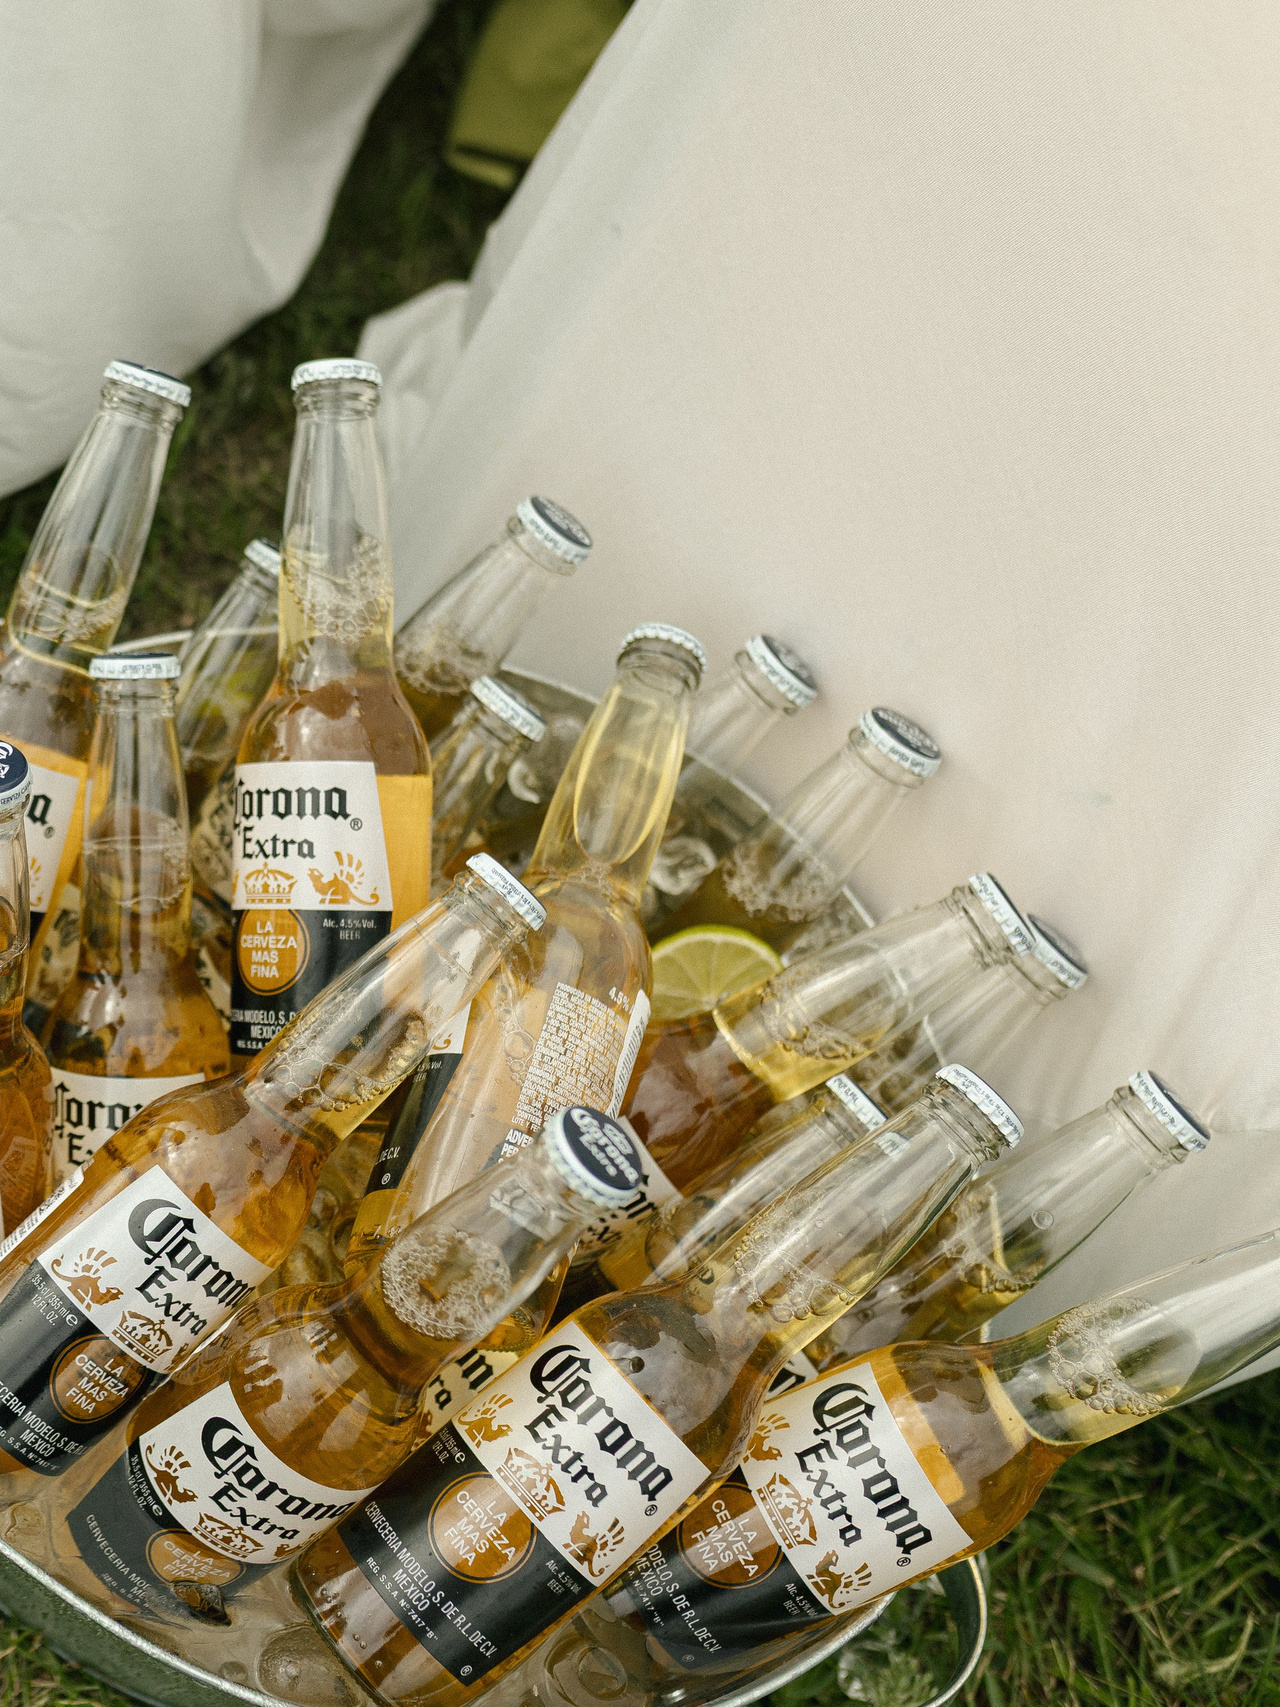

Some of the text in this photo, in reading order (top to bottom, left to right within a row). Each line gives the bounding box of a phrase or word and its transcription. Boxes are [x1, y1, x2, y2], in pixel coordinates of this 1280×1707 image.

[241, 826, 316, 859] Extra
[241, 935, 297, 948] CERVEZA
[256, 920, 274, 933] LA
[340, 919, 360, 928] 4.5%
[362, 920, 376, 929] Vol.
[250, 965, 279, 978] FINA
[252, 950, 279, 963] MAS
[608, 985, 631, 1011] 4.5%
[570, 1107, 639, 1185] Corona
[46, 1310, 59, 1326] OZ.
[135, 1265, 208, 1337] Extra
[75, 1353, 129, 1398] CERVEZA
[104, 1358, 125, 1378] LA
[65, 1387, 97, 1414] FINA
[78, 1377, 108, 1402] MAS
[529, 1343, 674, 1502] Corona
[20, 1429, 56, 1457] MEXICO
[524, 1403, 610, 1508] Extra
[812, 1382, 933, 1556] Corona
[794, 1438, 862, 1548] Extra
[208, 1481, 301, 1541] Extra
[456, 1490, 516, 1561] CERVEZA
[485, 1501, 508, 1526] LA
[86, 1514, 130, 1576] CERVECERIA
[443, 1527, 477, 1567] FINA
[456, 1517, 490, 1554] MAS
[705, 1525, 734, 1564] MAS
[711, 1499, 759, 1578] CERVEZA
[737, 1517, 758, 1544] LA
[163, 1540, 231, 1578] CERVEZA
[172, 1560, 209, 1577] MAS
[192, 1550, 214, 1566] LA
[545, 1559, 558, 1575] Alc.
[646, 1543, 673, 1585] ODELO,
[691, 1531, 720, 1572] FINA
[364, 1501, 403, 1553] CERVECERIA
[431, 1591, 445, 1607] S.
[440, 1601, 460, 1620] DE
[468, 1630, 486, 1648] DE
[366, 1556, 380, 1577] REG.
[407, 1609, 426, 1628] 7417
[392, 1568, 430, 1611] MEXICO
[665, 1582, 680, 1597] S.
[672, 1593, 691, 1612] DE
[694, 1625, 712, 1644] DE
